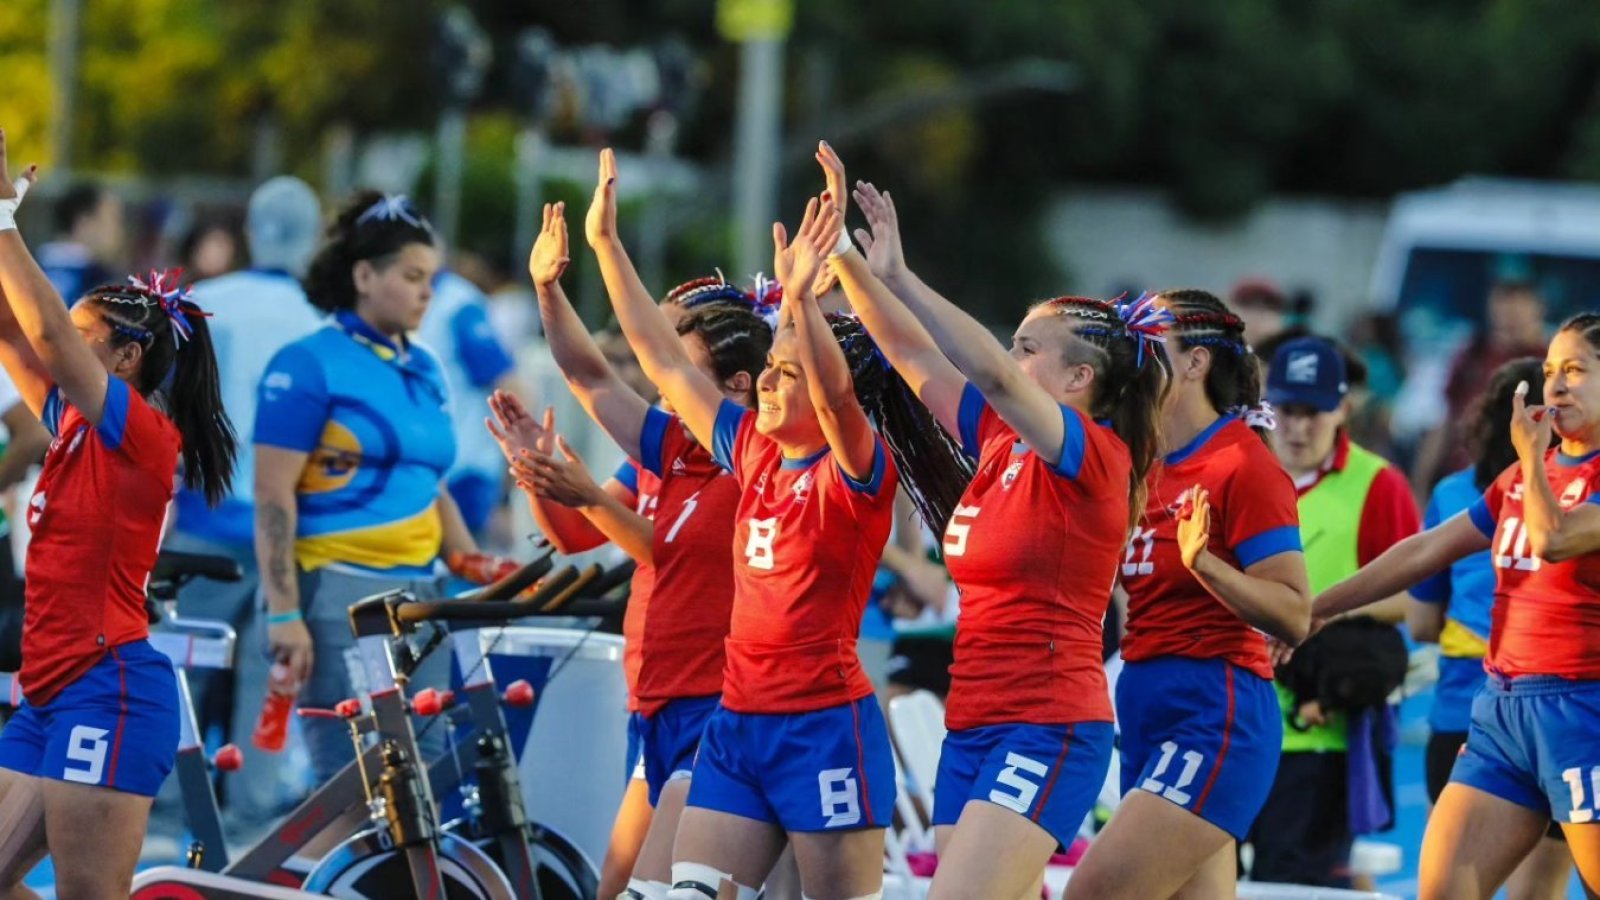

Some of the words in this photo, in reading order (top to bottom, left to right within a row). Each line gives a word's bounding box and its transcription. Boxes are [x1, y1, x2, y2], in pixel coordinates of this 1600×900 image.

[745, 517, 778, 570] 8
[943, 503, 981, 557] 5
[1121, 526, 1157, 576] 11
[63, 724, 110, 785] 9
[988, 751, 1049, 814] 5
[1140, 740, 1204, 806] 11
[817, 767, 861, 828] 8
